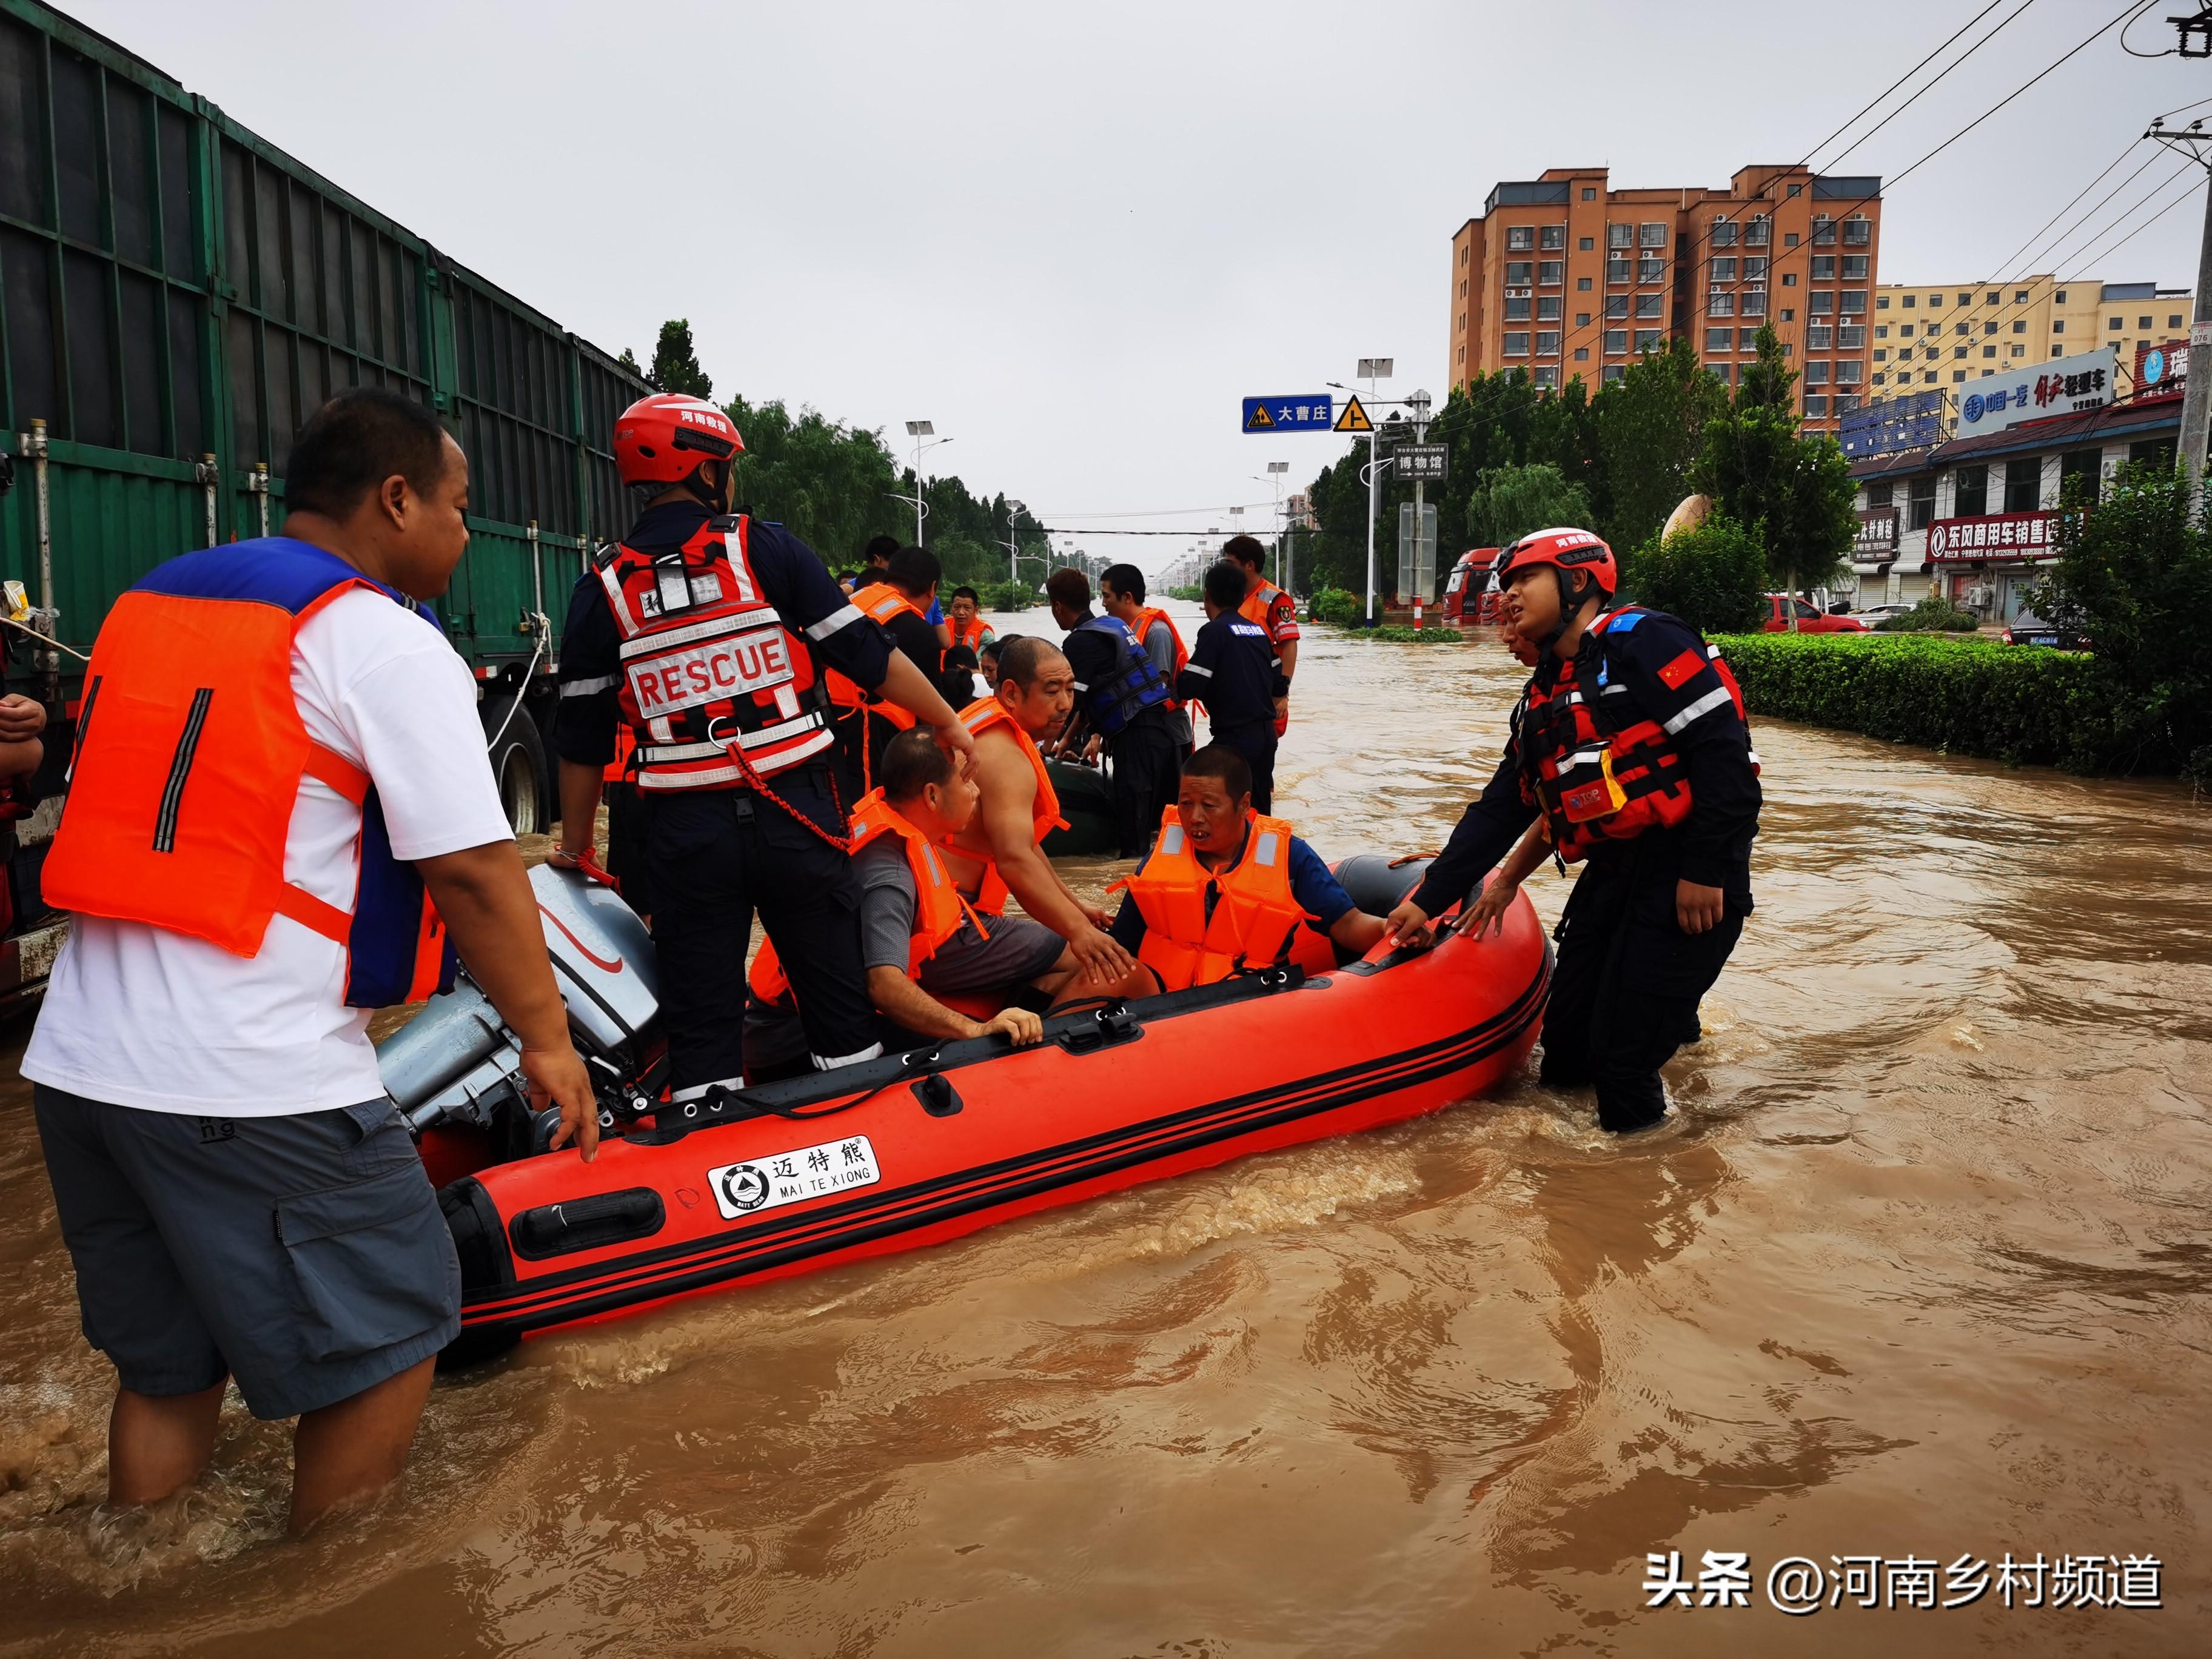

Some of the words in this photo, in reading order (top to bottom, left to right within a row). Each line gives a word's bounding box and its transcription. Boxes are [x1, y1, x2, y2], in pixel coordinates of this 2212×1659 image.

[1278, 405, 1327, 421] 大曹庄
[681, 411, 727, 434] 河南救援
[1399, 455, 1442, 469] 博物馆
[1555, 534, 1598, 548] 河南救援
[637, 638, 786, 708] RESCUE
[1580, 789, 1599, 802] TOP
[773, 1142, 865, 1178] 迈特熊
[780, 1184, 803, 1198] MAI
[809, 1178, 826, 1191] TE
[830, 1167, 870, 1187] XIONG
[752, 1196, 765, 1207] BEAR
